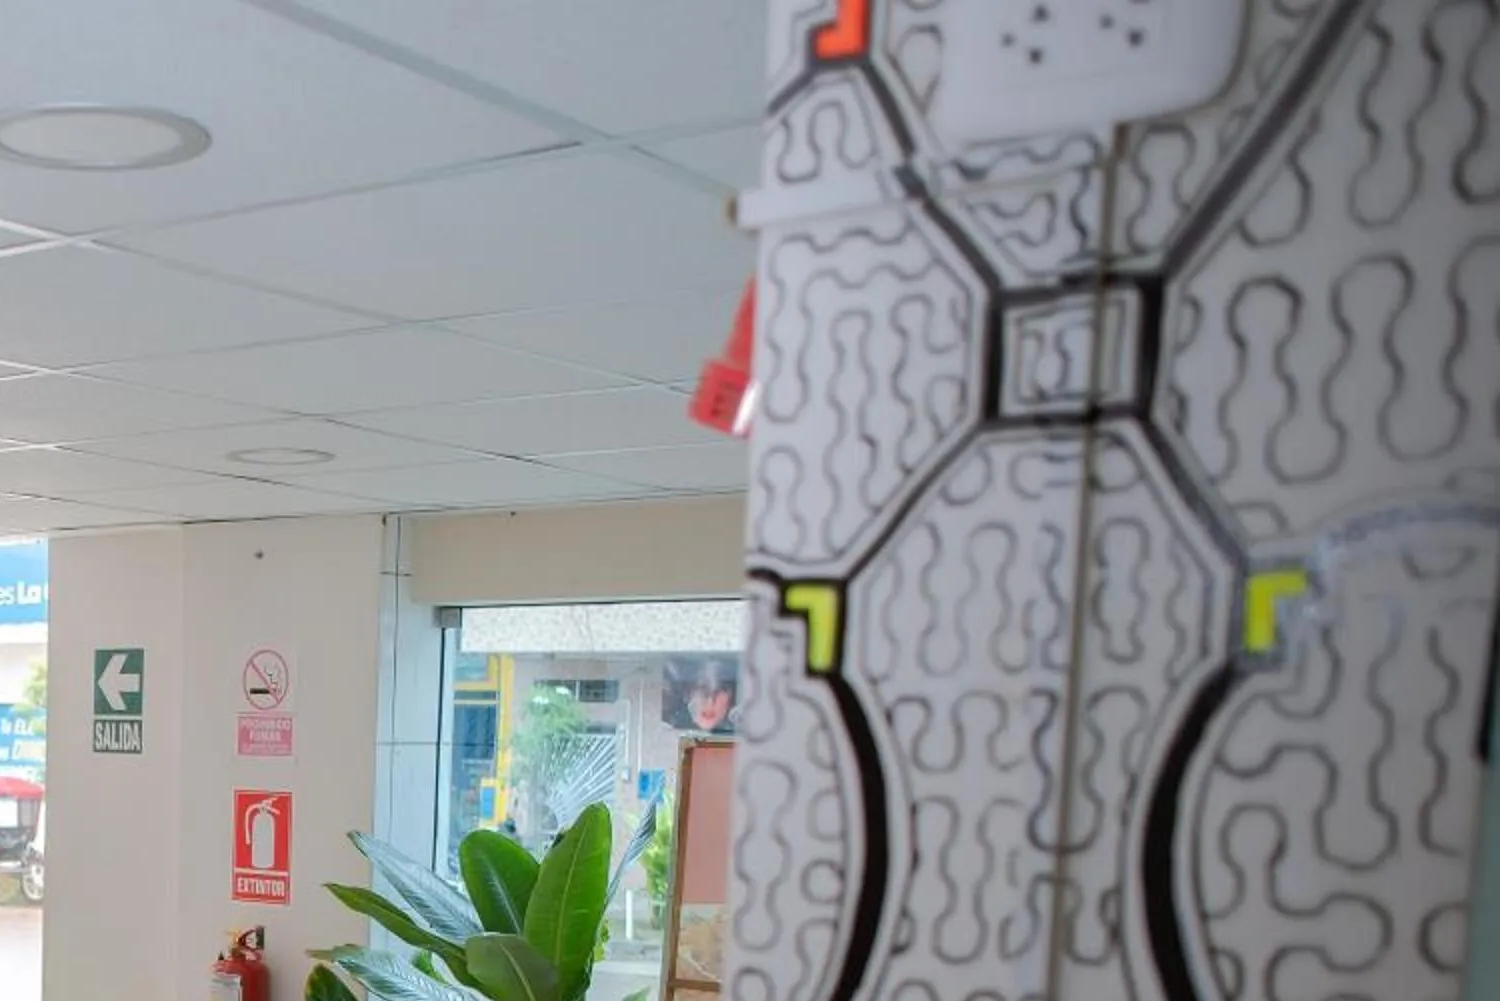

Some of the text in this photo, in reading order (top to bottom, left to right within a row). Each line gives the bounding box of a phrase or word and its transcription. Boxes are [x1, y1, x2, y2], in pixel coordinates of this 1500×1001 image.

[18, 581, 40, 604] La
[95, 722, 141, 752] SALIDA
[237, 877, 285, 897] EXTINTOR
